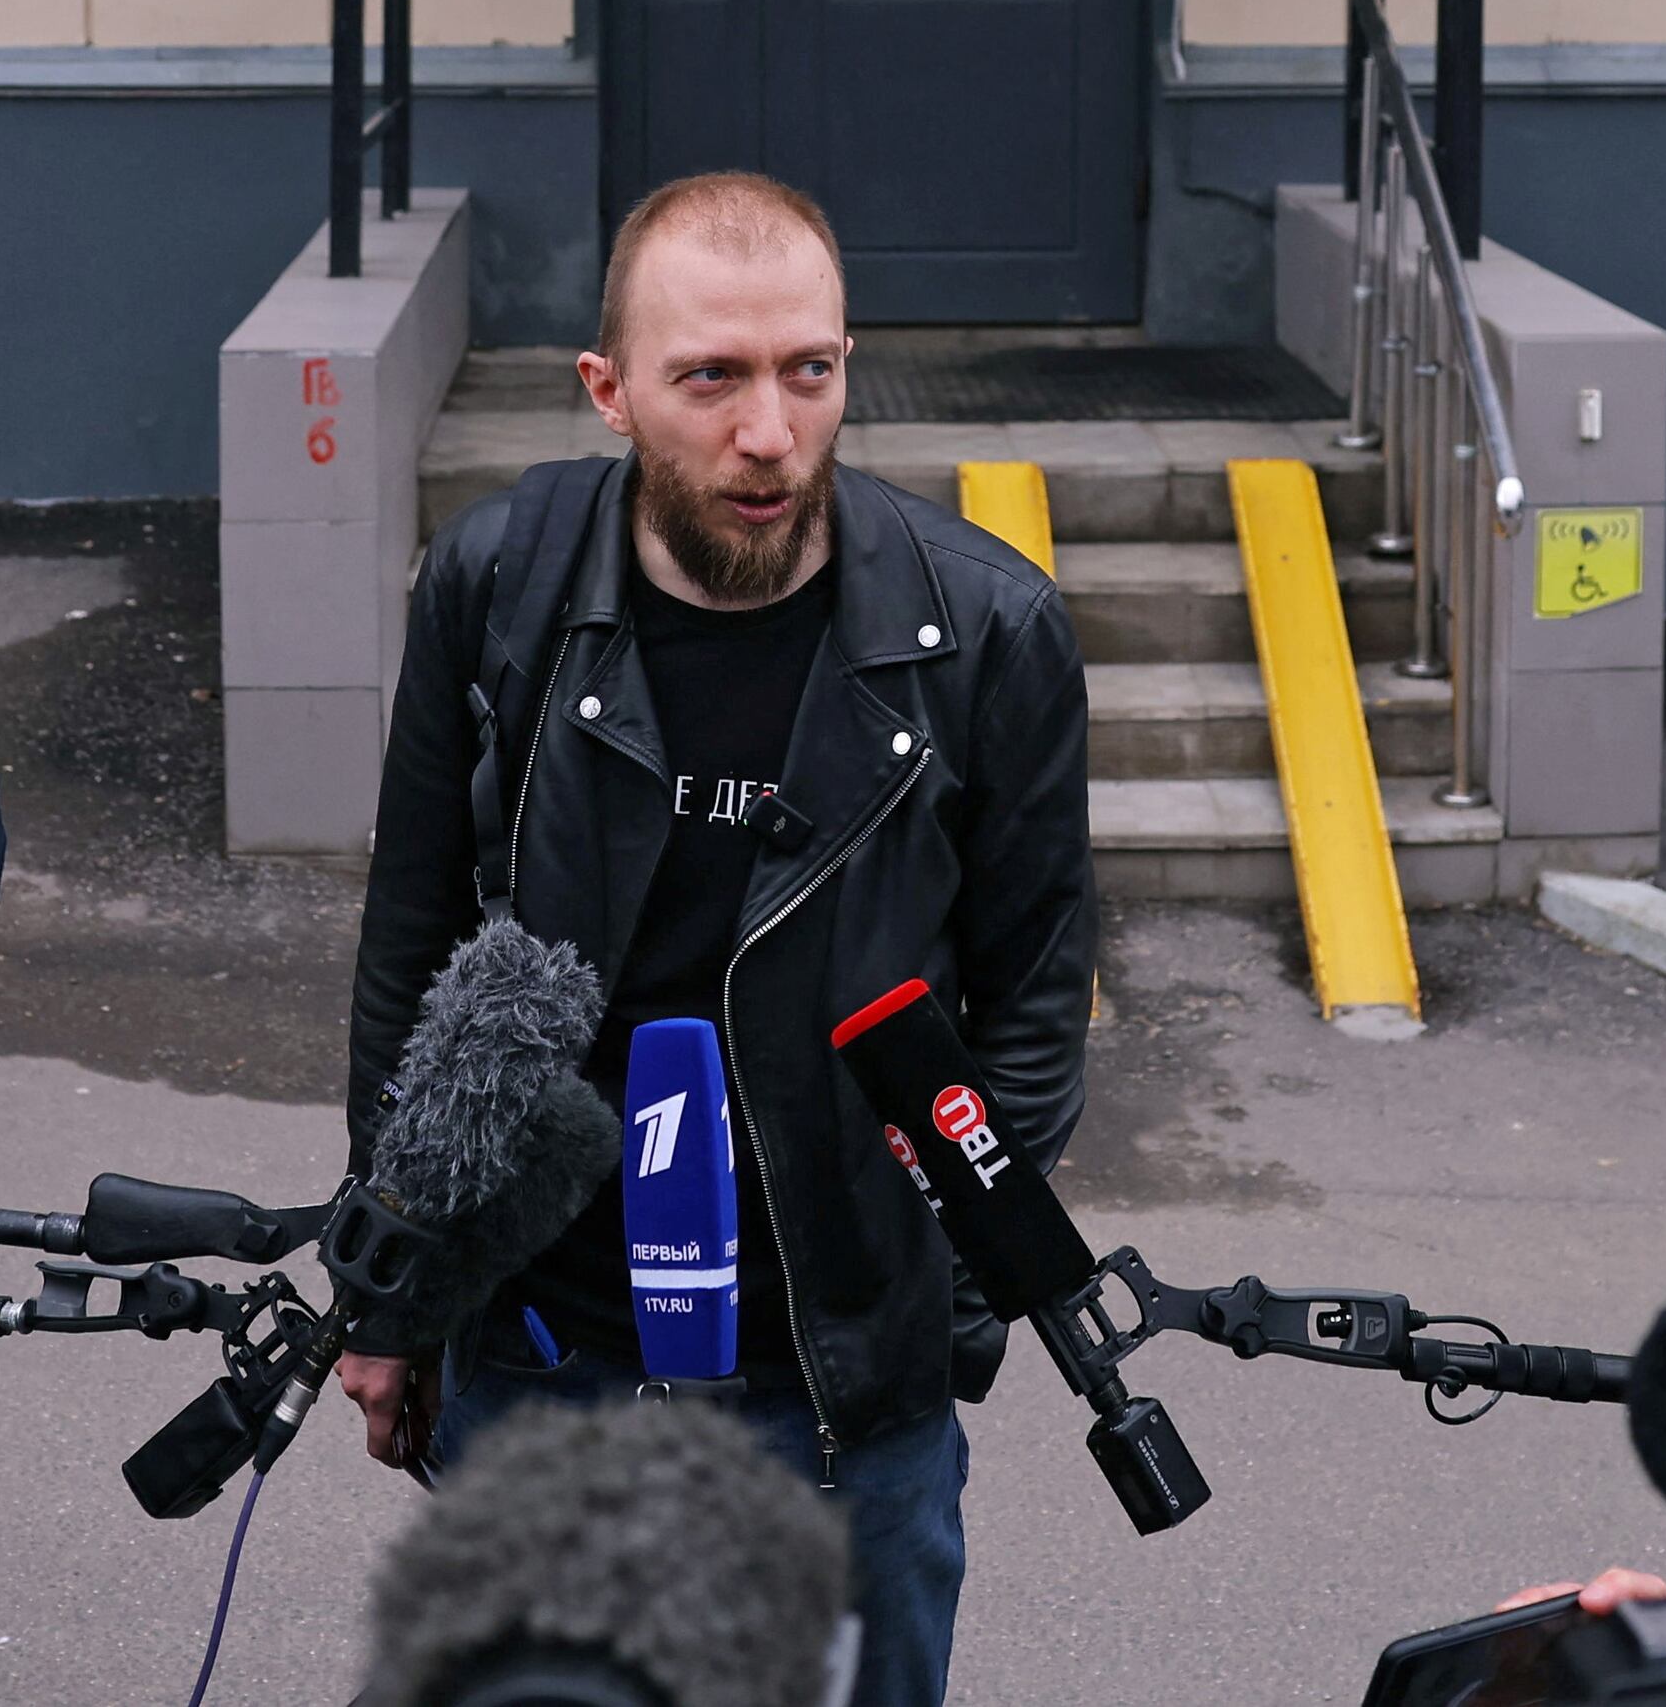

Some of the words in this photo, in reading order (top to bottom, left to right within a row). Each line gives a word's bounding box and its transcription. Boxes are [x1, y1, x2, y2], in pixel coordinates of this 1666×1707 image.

[936, 1087, 1011, 1190] ТВЦ
[632, 1240, 701, 1261] ПЕРВЫЙ
[644, 1297, 694, 1313] 1TV.RU
